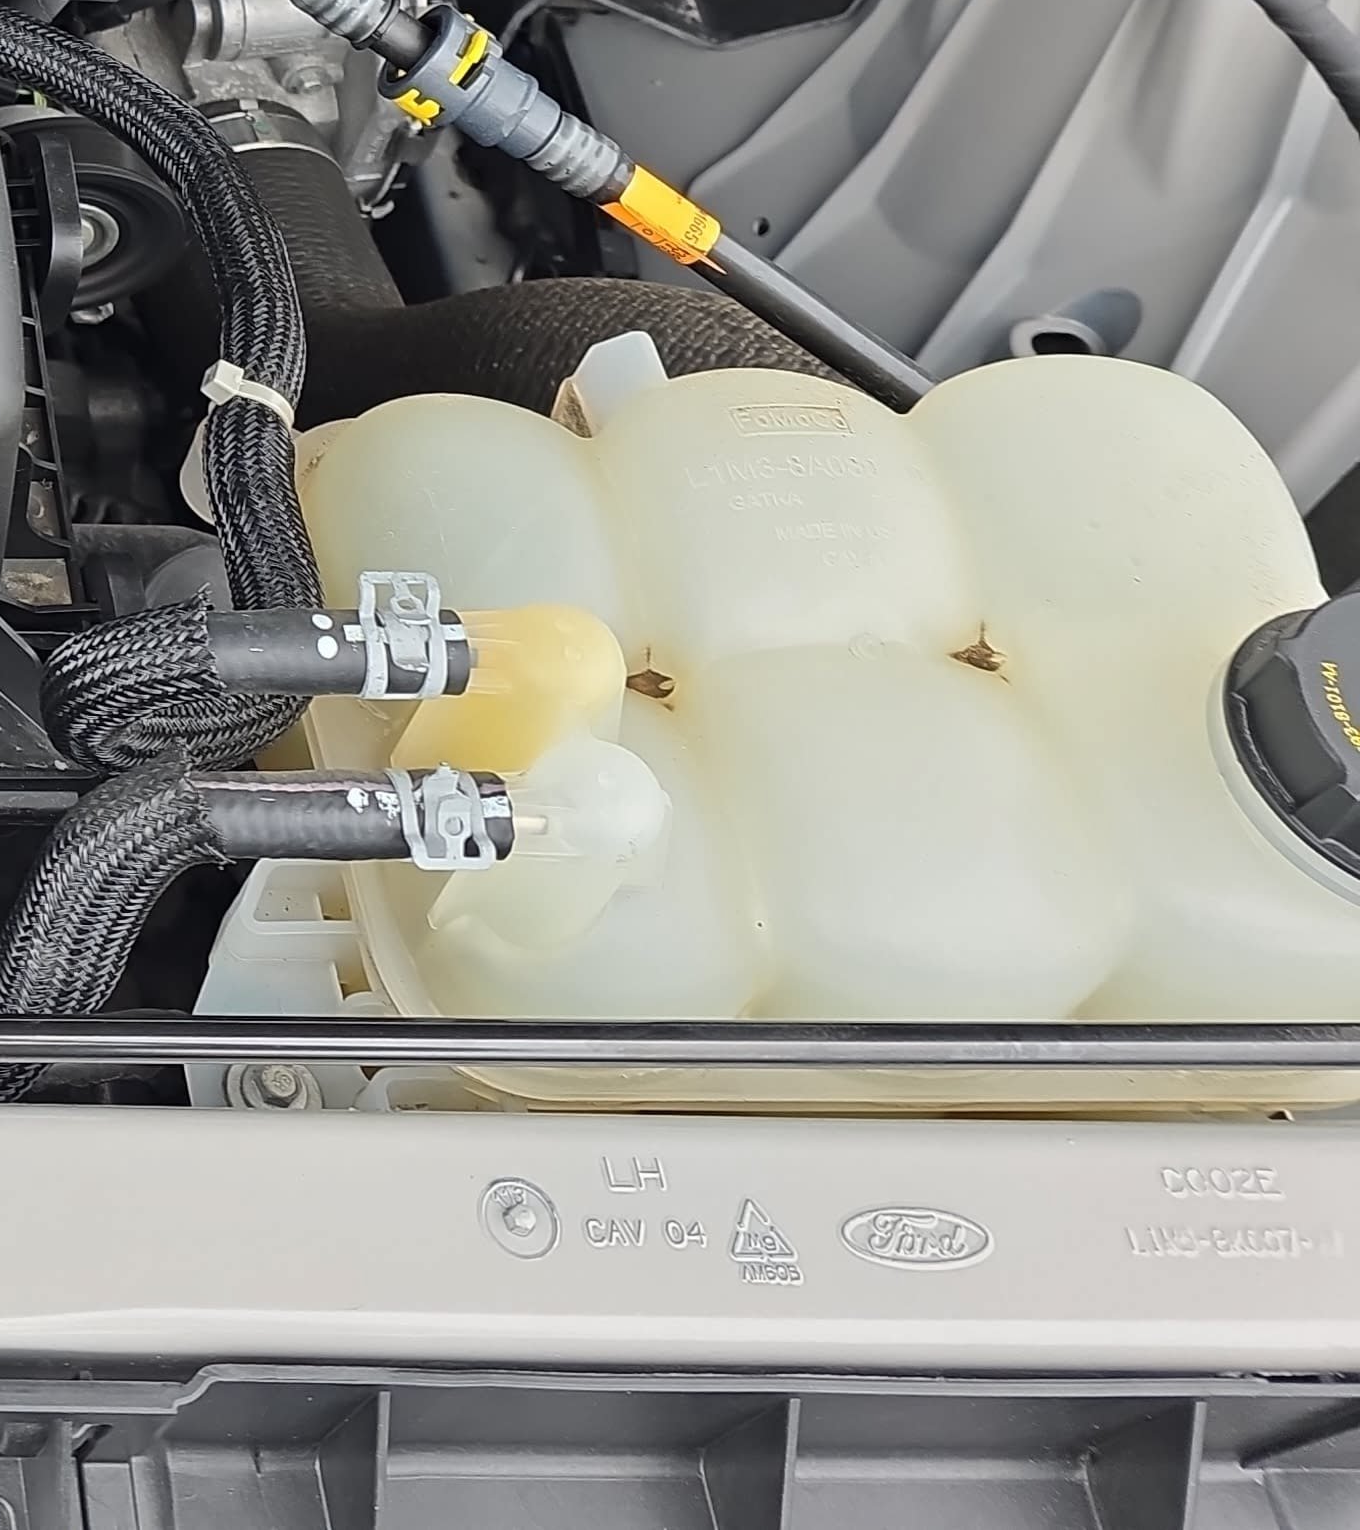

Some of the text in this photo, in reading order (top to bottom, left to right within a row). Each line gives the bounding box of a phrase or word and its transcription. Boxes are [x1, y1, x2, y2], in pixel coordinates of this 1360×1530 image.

[600, 1154, 668, 1194] LH
[584, 1217, 708, 1250] CAV 04
